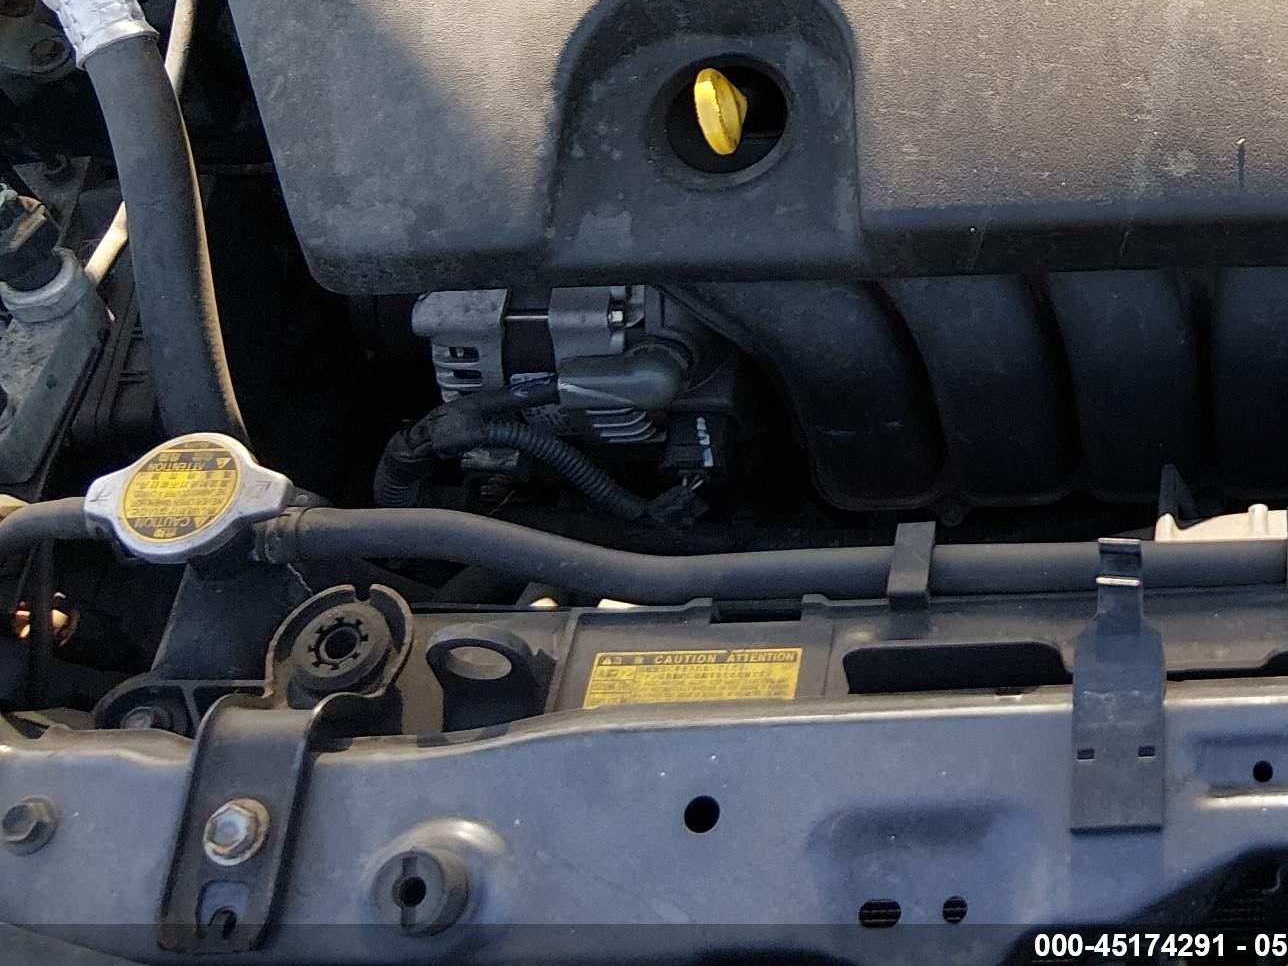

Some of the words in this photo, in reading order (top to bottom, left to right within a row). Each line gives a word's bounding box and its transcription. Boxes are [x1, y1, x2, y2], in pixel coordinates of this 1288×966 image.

[146, 462, 205, 472] ATTENTION
[135, 517, 190, 527] CAUTION
[653, 653, 717, 665] CAUTION
[726, 651, 796, 664] ATTENTION
